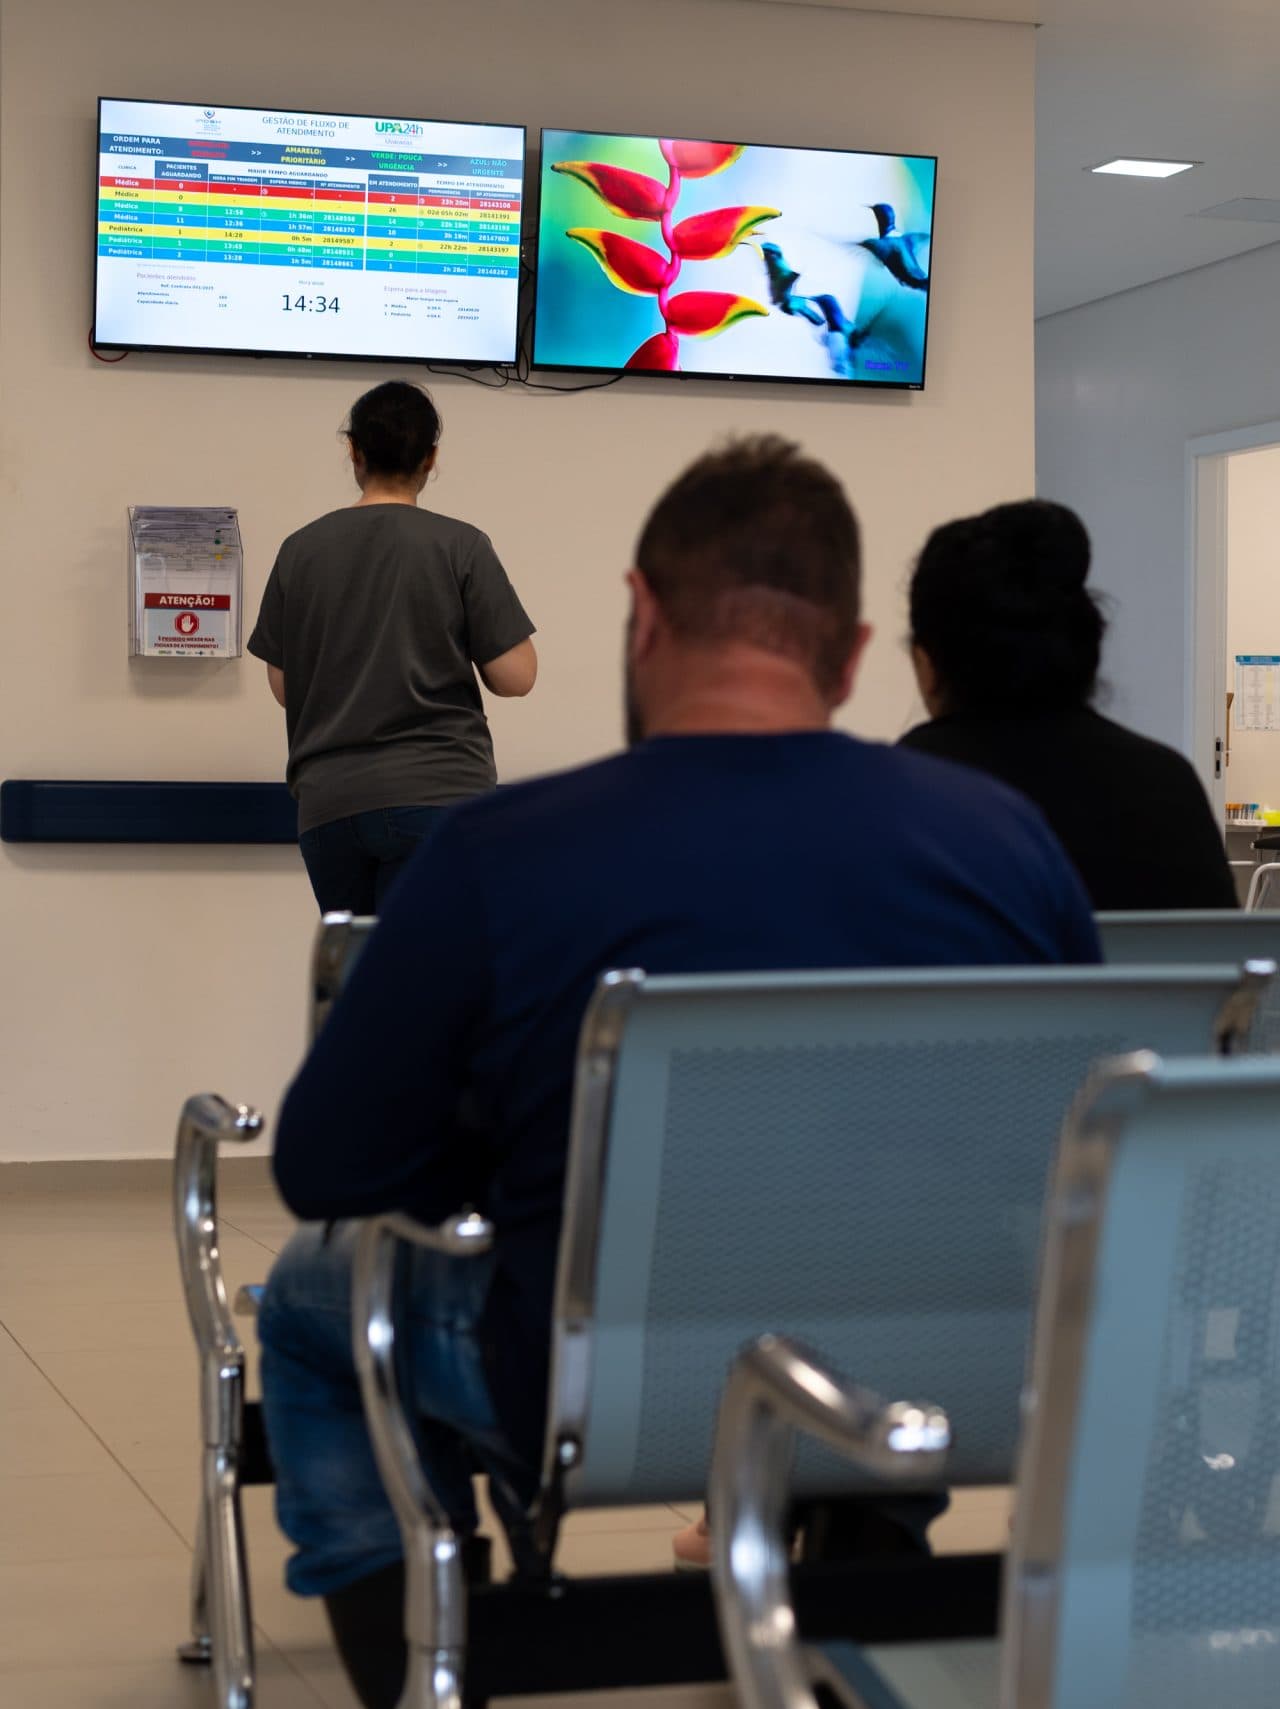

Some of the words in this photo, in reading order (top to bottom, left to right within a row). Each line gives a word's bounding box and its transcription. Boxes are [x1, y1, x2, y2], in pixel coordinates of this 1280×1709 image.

[262, 116, 295, 126] GESTÃO
[310, 120, 337, 128] FLUXO
[338, 121, 350, 129] DE
[277, 128, 335, 138] ATENDIMENTO
[113, 136, 140, 144] ORDEM
[141, 137, 161, 145] PARA
[109, 146, 164, 155] ATENDIMENTO:
[285, 146, 322, 155] AMARELO:
[281, 156, 327, 165] PRIORITÁRIO
[398, 153, 423, 161] POUCA
[166, 163, 197, 171] PACIENTES
[161, 171, 202, 179] AGUARDANDO
[115, 190, 139, 198] Médica
[114, 213, 138, 221] Médica
[281, 294, 340, 314] 14:34
[160, 595, 215, 608] ATENÇÃO!
